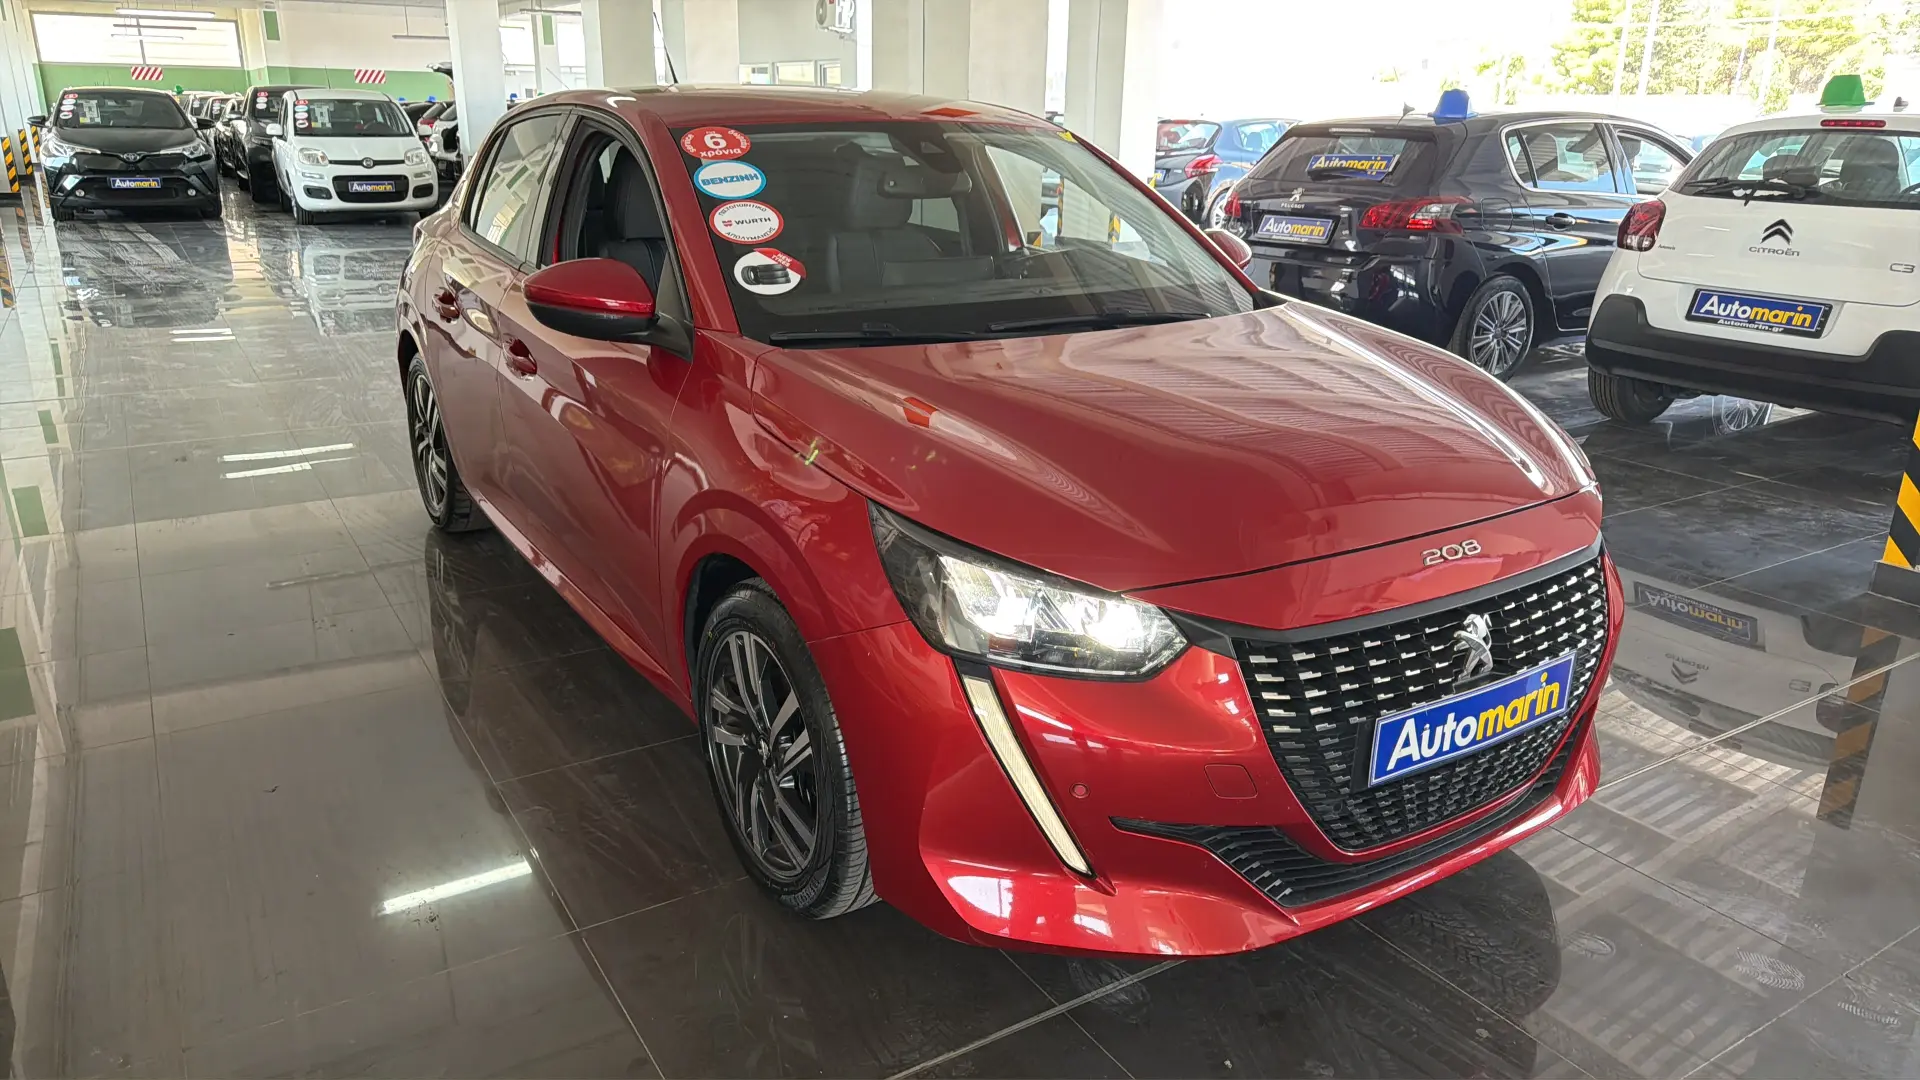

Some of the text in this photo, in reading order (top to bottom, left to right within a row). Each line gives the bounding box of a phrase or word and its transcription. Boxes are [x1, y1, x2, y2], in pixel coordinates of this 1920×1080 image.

[704, 133, 727, 149] 6
[700, 147, 742, 158] χρόνια
[1312, 156, 1387, 171] Automarin
[115, 179, 158, 188] Automarin
[353, 182, 393, 191] Automarin
[1263, 217, 1326, 237] Automarin
[1890, 262, 1916, 274] C3
[1700, 295, 1813, 328] Automarin
[1717, 318, 1785, 334] Automarin.gr
[1422, 539, 1482, 567] 208
[1386, 671, 1561, 772] Automarin
